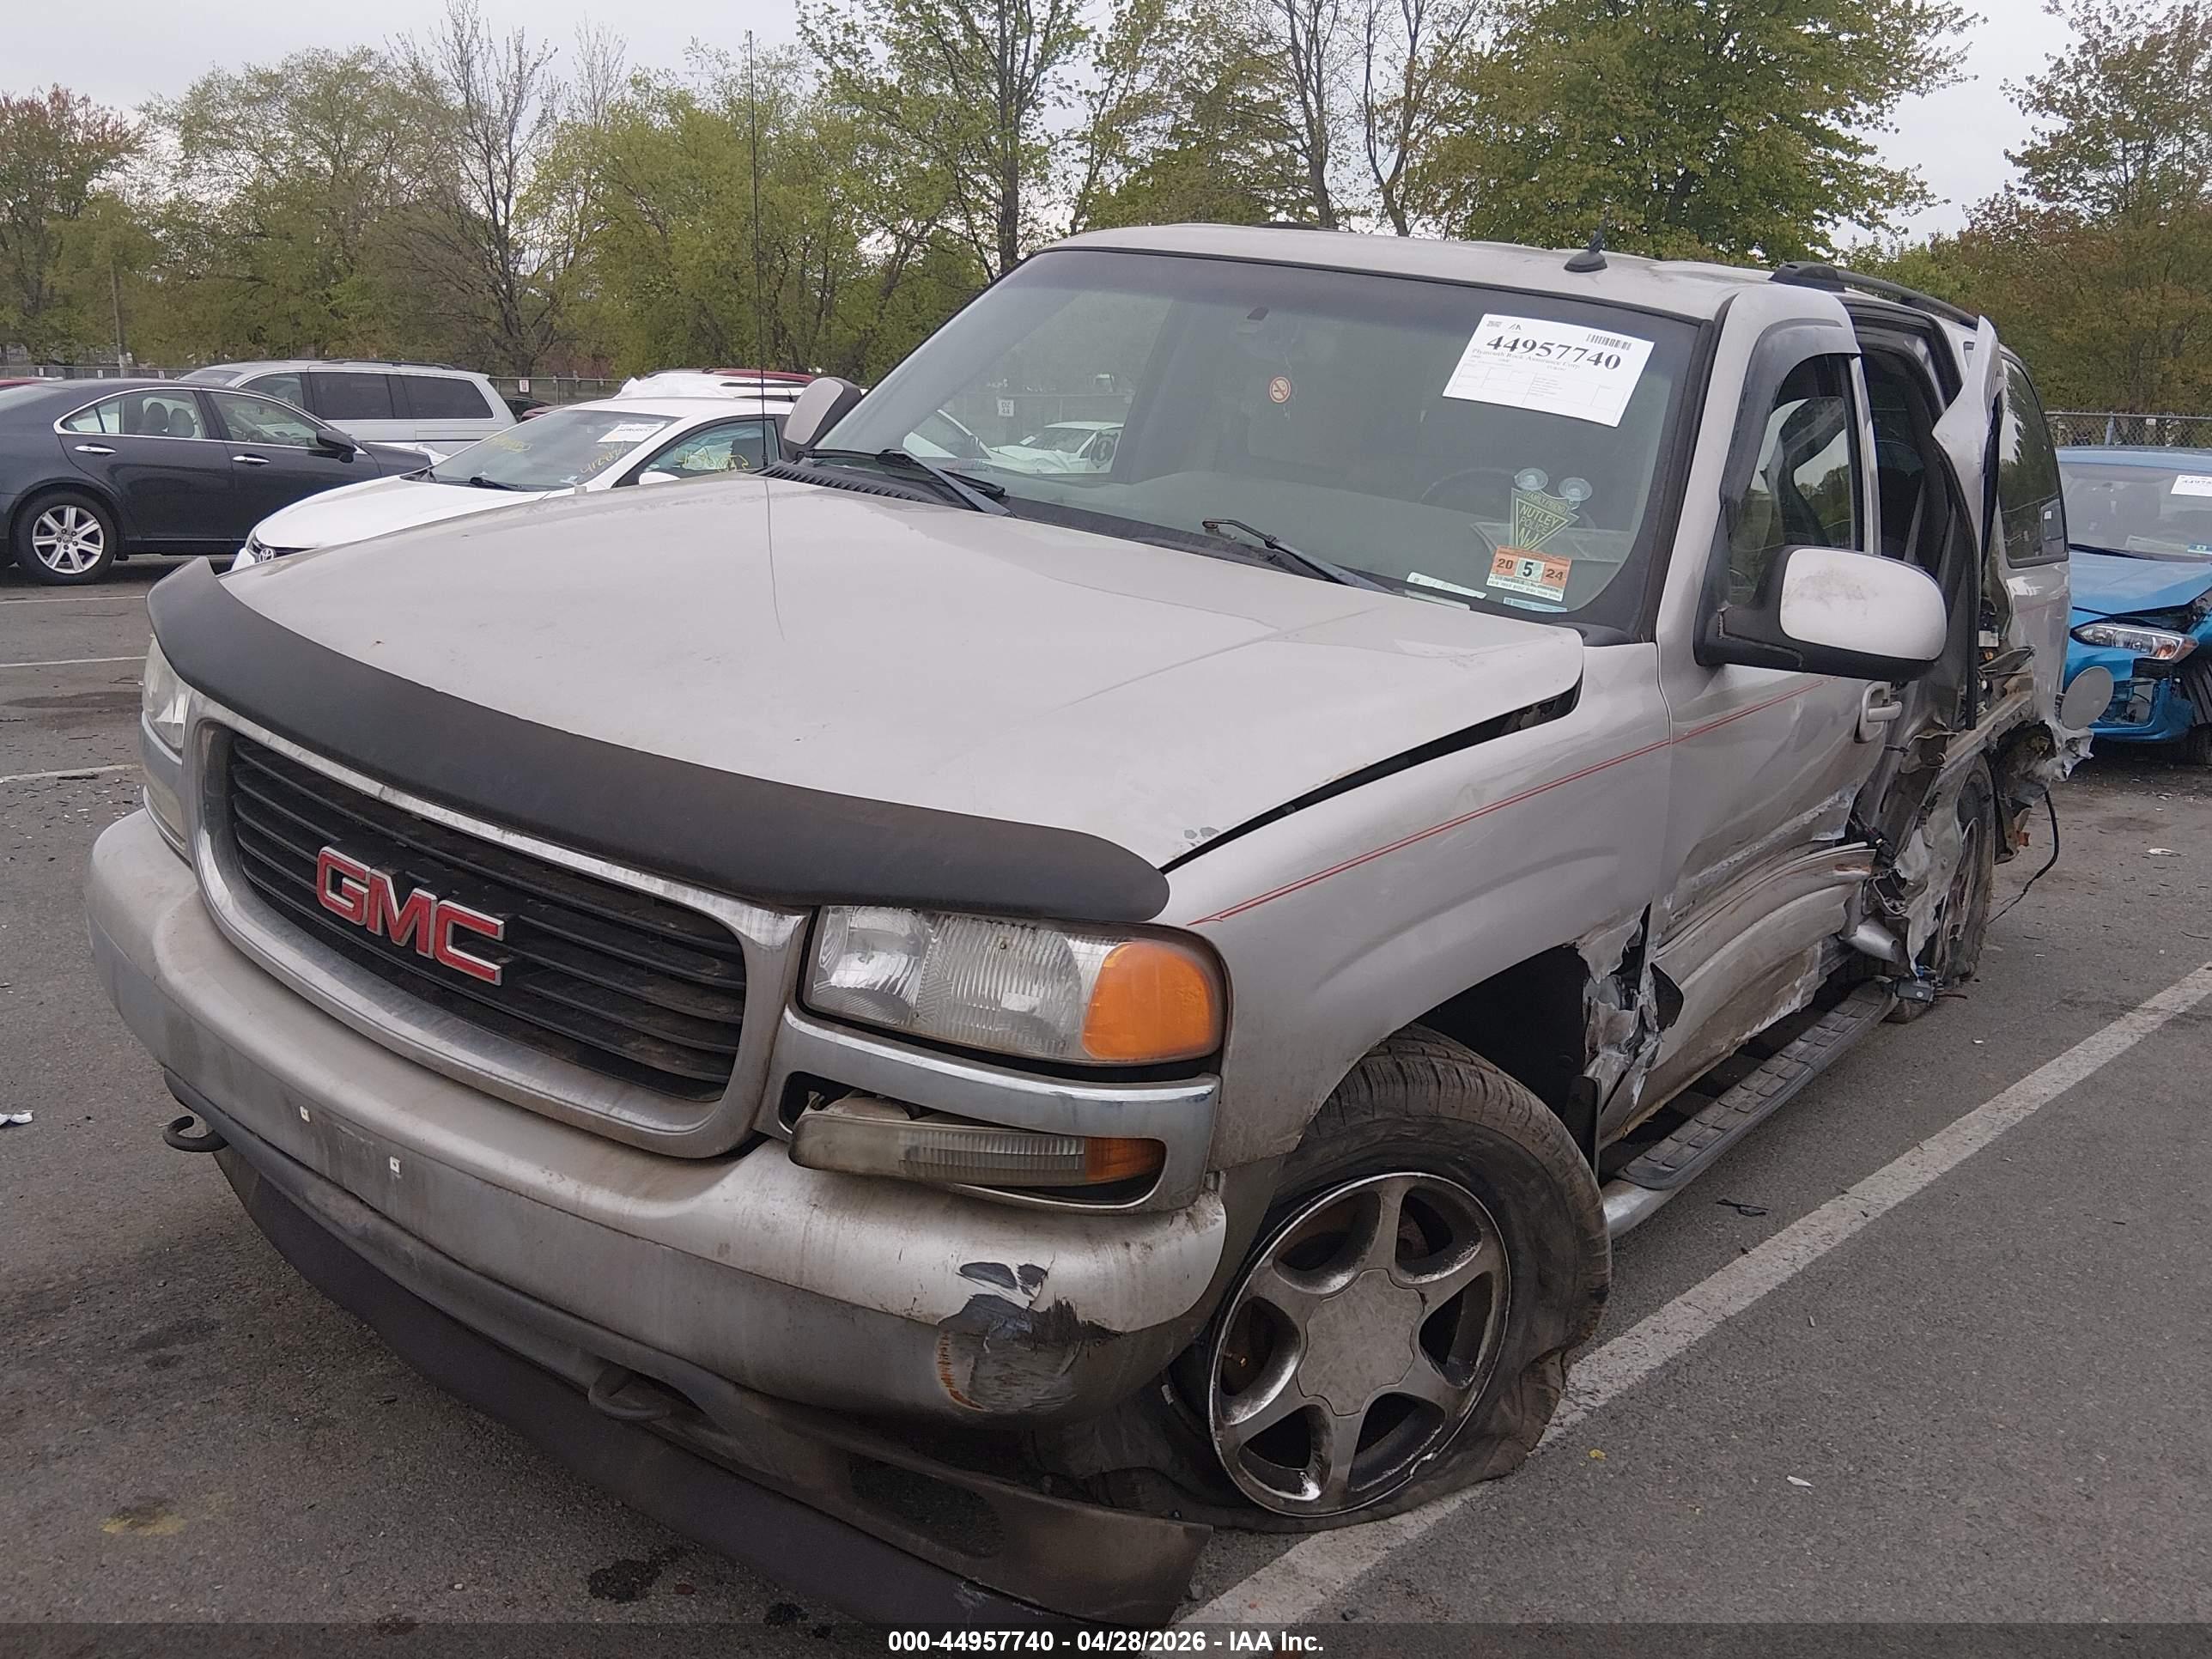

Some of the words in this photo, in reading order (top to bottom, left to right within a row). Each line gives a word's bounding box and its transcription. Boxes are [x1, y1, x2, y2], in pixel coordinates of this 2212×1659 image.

[1486, 335, 1621, 370] 44957740
[1519, 504, 1559, 527] NUTLEY
[1519, 516, 1550, 536] POLICE
[1497, 558, 1514, 569] 20
[1522, 562, 1534, 577] 5
[1546, 569, 1564, 581] 24
[316, 847, 504, 986] GMC
